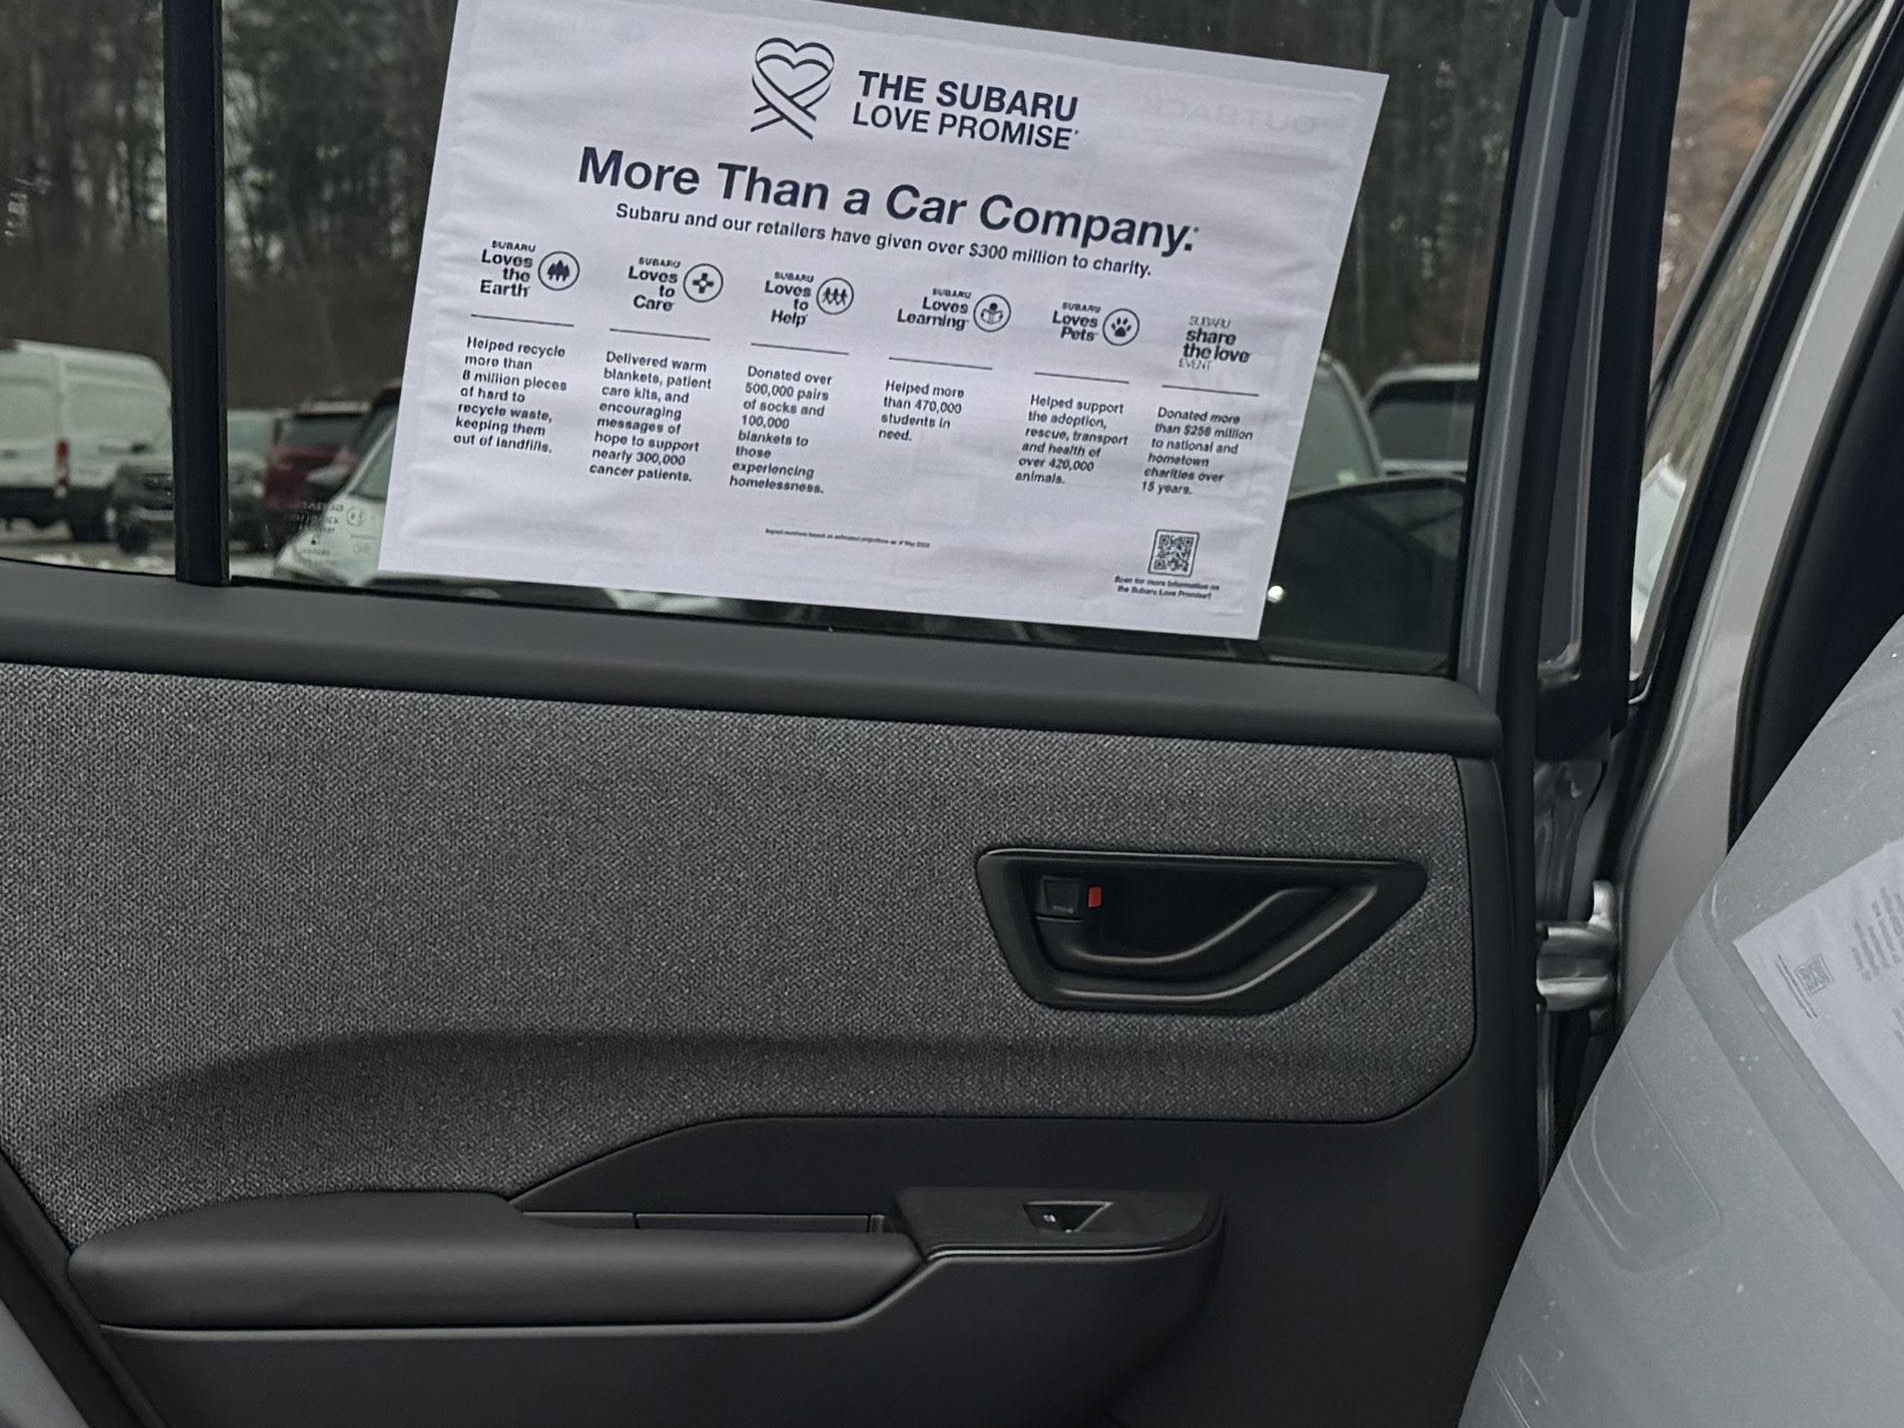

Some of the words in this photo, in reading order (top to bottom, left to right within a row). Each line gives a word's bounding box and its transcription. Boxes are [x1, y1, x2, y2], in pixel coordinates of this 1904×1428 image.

[857, 69, 927, 104] THE
[935, 79, 1078, 122] SUBARU
[851, 100, 931, 133] LOVE
[937, 111, 1073, 150] PROMISE
[577, 145, 700, 195] More
[716, 161, 829, 211] Than
[842, 187, 870, 216] a
[885, 183, 968, 225] Car
[979, 193, 1199, 258] Company.
[615, 202, 680, 224] Subaru
[683, 212, 718, 228] and
[721, 217, 753, 232] our
[755, 219, 826, 240] retailers
[829, 225, 872, 245] have
[874, 232, 922, 251] given
[926, 240, 965, 255] over
[967, 241, 1008, 260] $300
[1010, 247, 1068, 267] million
[1071, 253, 1089, 269] to
[1091, 256, 1151, 279] charity.
[479, 247, 534, 269] Loves
[500, 265, 531, 283] the
[626, 264, 678, 284] Loves
[479, 278, 530, 298] Earth
[657, 283, 676, 298] to
[763, 278, 812, 298] Loves
[632, 294, 673, 312] Care
[792, 296, 809, 313] to
[921, 295, 969, 315] Loves
[769, 308, 807, 329] Help
[896, 307, 967, 332] Learning
[1051, 308, 1099, 329] Loves
[1059, 323, 1096, 342] Pets
[1184, 325, 1237, 346] share
[465, 334, 514, 354] Helped
[516, 343, 566, 359] recycle
[1181, 341, 1212, 361] the
[1212, 344, 1250, 364] love
[463, 354, 500, 368] more
[502, 355, 533, 371] than
[605, 349, 668, 369] Delivered
[670, 358, 707, 373] warm
[472, 370, 520, 387] million
[522, 375, 567, 392] pieces
[602, 366, 663, 387] blankets,
[665, 373, 712, 390] patient
[746, 364, 802, 383] Donated
[803, 372, 833, 385] over
[459, 384, 475, 398] of
[476, 385, 509, 402] hard
[511, 390, 526, 403] to
[600, 385, 631, 398] care
[632, 385, 662, 403] kits,
[663, 390, 690, 404] and
[744, 380, 795, 398] 500,000
[795, 386, 829, 402] pairs
[884, 378, 930, 396] Helped
[931, 385, 965, 399] more
[456, 402, 507, 418] recycle
[509, 407, 552, 424] waste,
[598, 401, 682, 422] encouraging
[742, 397, 757, 411] of
[758, 400, 798, 415] socks
[799, 403, 826, 417] and
[882, 394, 911, 410] than
[913, 397, 962, 415] 470,000
[1029, 392, 1074, 410] Helped
[1075, 399, 1124, 415] support
[741, 413, 790, 430] 100,000
[880, 411, 936, 428] students
[937, 416, 951, 429] in
[1027, 409, 1048, 423] the
[1049, 411, 1107, 431] adoption,
[1156, 405, 1209, 422] Donated
[1208, 412, 1241, 425] more
[454, 414, 509, 436] keeping
[511, 421, 546, 437] them
[595, 416, 664, 434] messages
[666, 422, 682, 435] of
[877, 428, 912, 441] need.
[1153, 421, 1181, 435] than
[1212, 426, 1253, 440] million
[452, 432, 476, 445] out
[478, 433, 494, 447] of
[495, 435, 552, 454] landfills.
[593, 429, 628, 447] hope
[630, 433, 645, 448] to
[647, 437, 699, 454] support
[737, 428, 792, 446] blankets
[795, 434, 809, 447] to
[1024, 427, 1070, 442] rescue,
[1071, 428, 1129, 446] transport
[1150, 436, 1164, 449] to
[1165, 438, 1214, 453] national
[1215, 442, 1239, 455] and
[591, 447, 633, 465] nearly
[634, 450, 686, 466] 300,000
[734, 444, 772, 459] those
[1020, 440, 1046, 454] and
[1046, 441, 1086, 457] health
[1087, 446, 1102, 458] of
[1017, 456, 1046, 468] over
[1047, 456, 1095, 472] 420,000
[1146, 451, 1210, 468] hometown
[588, 463, 635, 477] cancer
[635, 466, 692, 482] patients.
[731, 461, 815, 481] experiencing
[1014, 469, 1065, 485] animals.
[1142, 465, 1196, 481] charities
[1196, 470, 1226, 483] over
[728, 473, 824, 494] homelessness.
[1141, 479, 1155, 492] 15
[1156, 482, 1192, 495] years.
